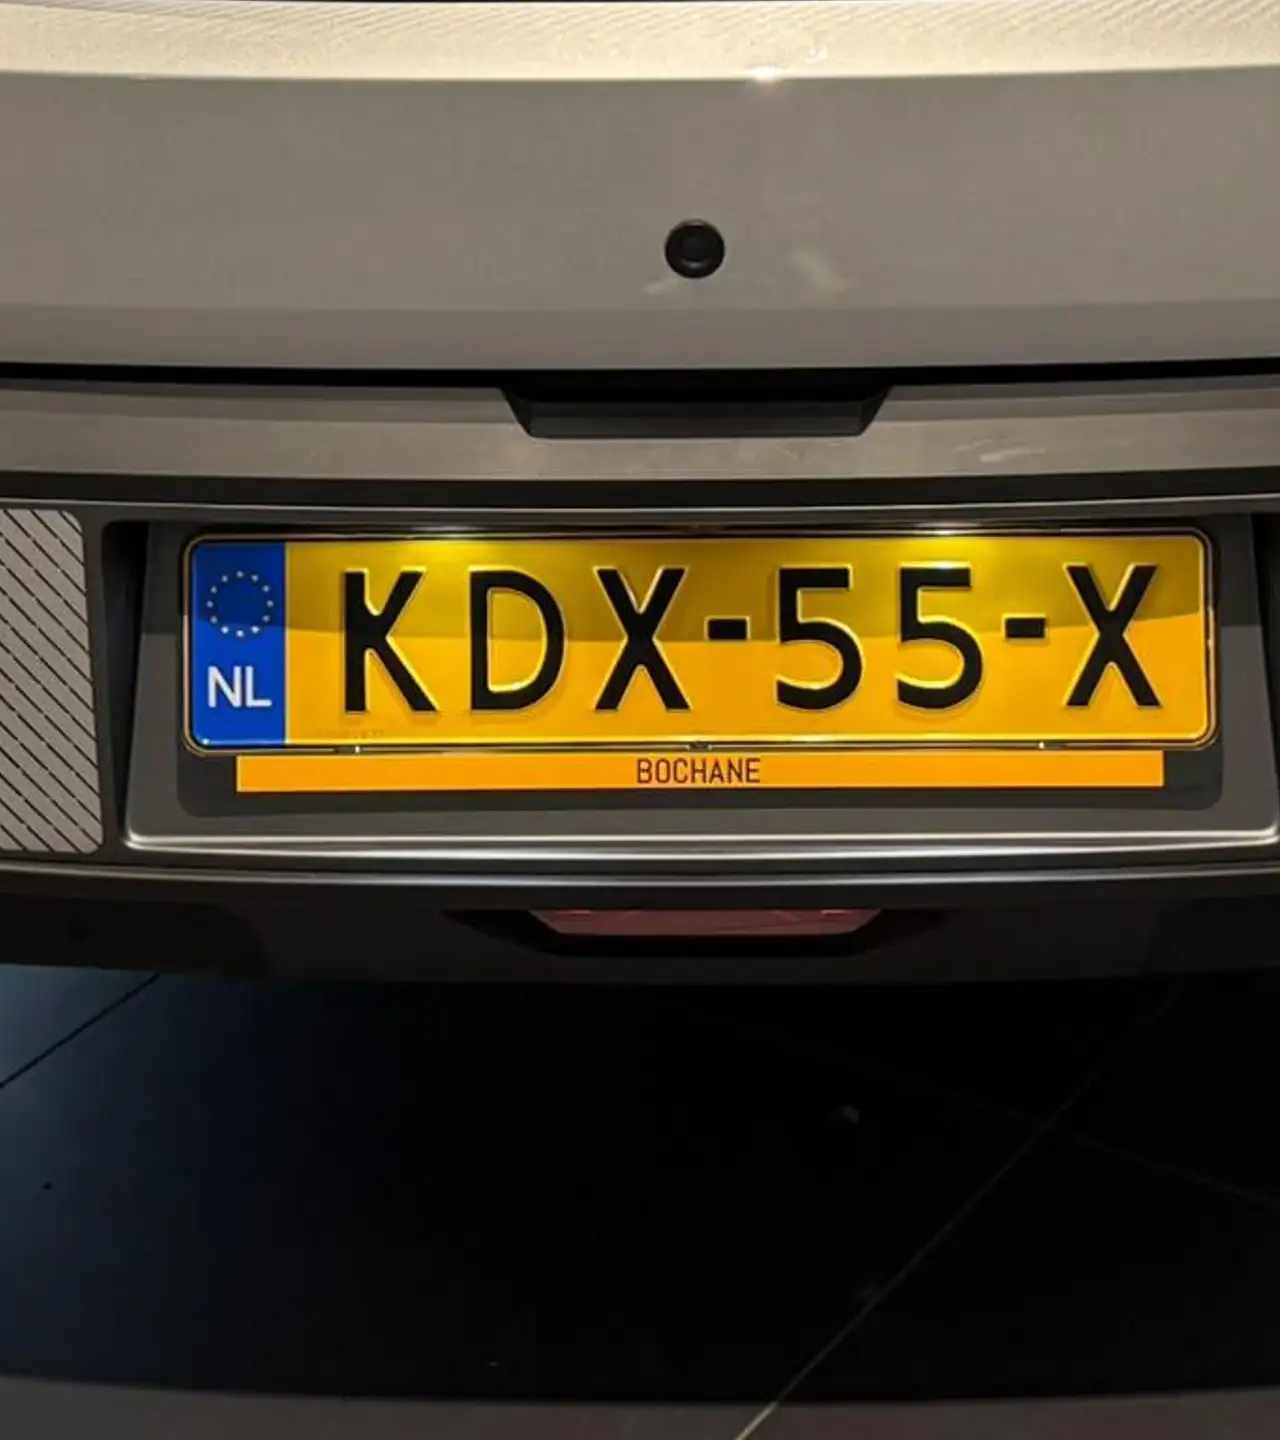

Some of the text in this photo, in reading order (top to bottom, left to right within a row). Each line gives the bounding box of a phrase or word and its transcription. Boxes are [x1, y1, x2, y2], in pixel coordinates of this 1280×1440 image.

[342, 564, 1163, 714] KDX-55-X
[207, 664, 273, 709] NL
[635, 756, 762, 785] BOCHANE
